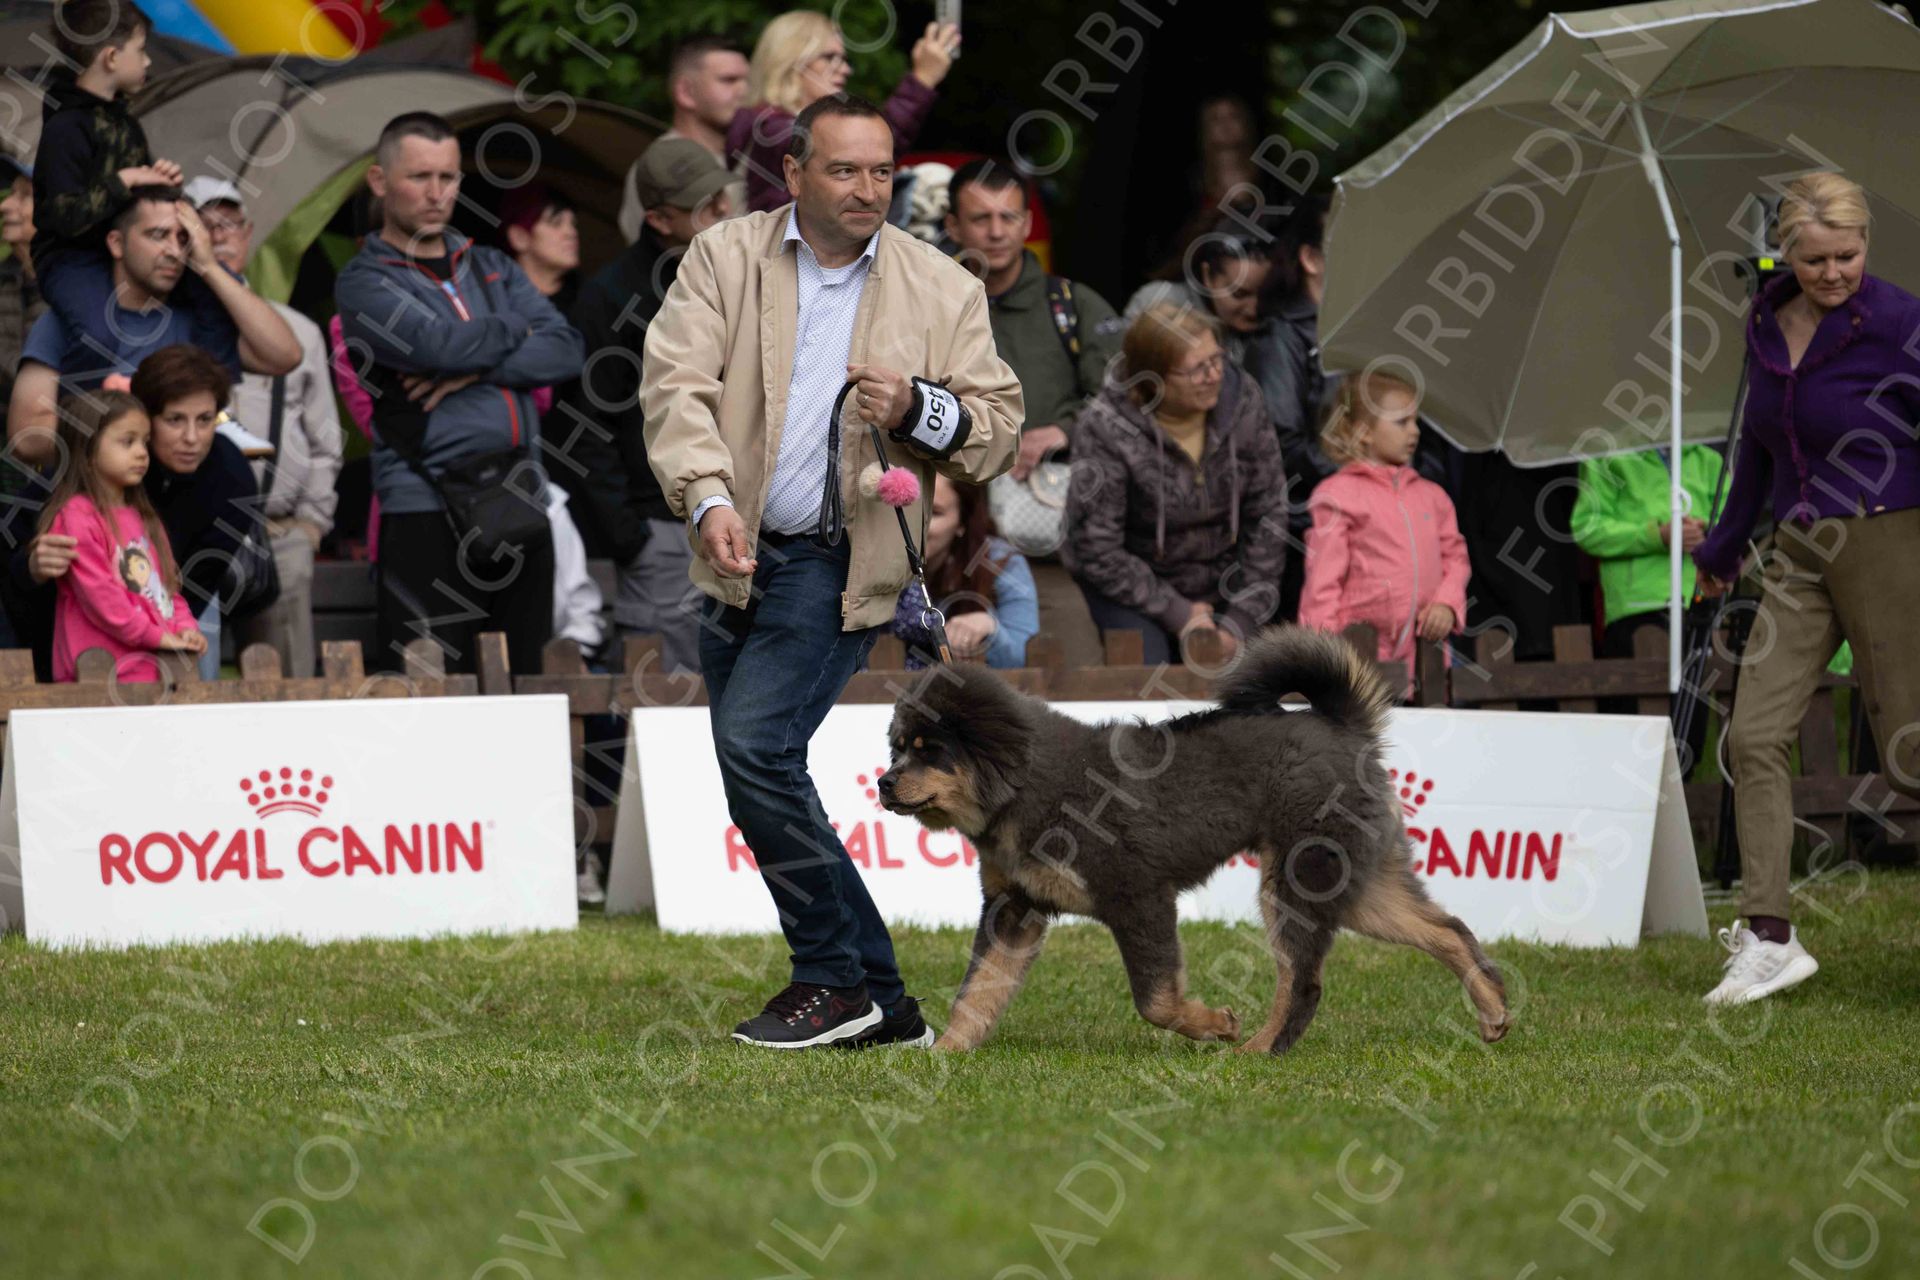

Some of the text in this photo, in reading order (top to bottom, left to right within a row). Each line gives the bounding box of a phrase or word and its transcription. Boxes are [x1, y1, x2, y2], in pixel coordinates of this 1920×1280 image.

[926, 387, 945, 431] 450
[99, 821, 483, 885] ROYAL CANIN
[725, 821, 905, 872] RAL
